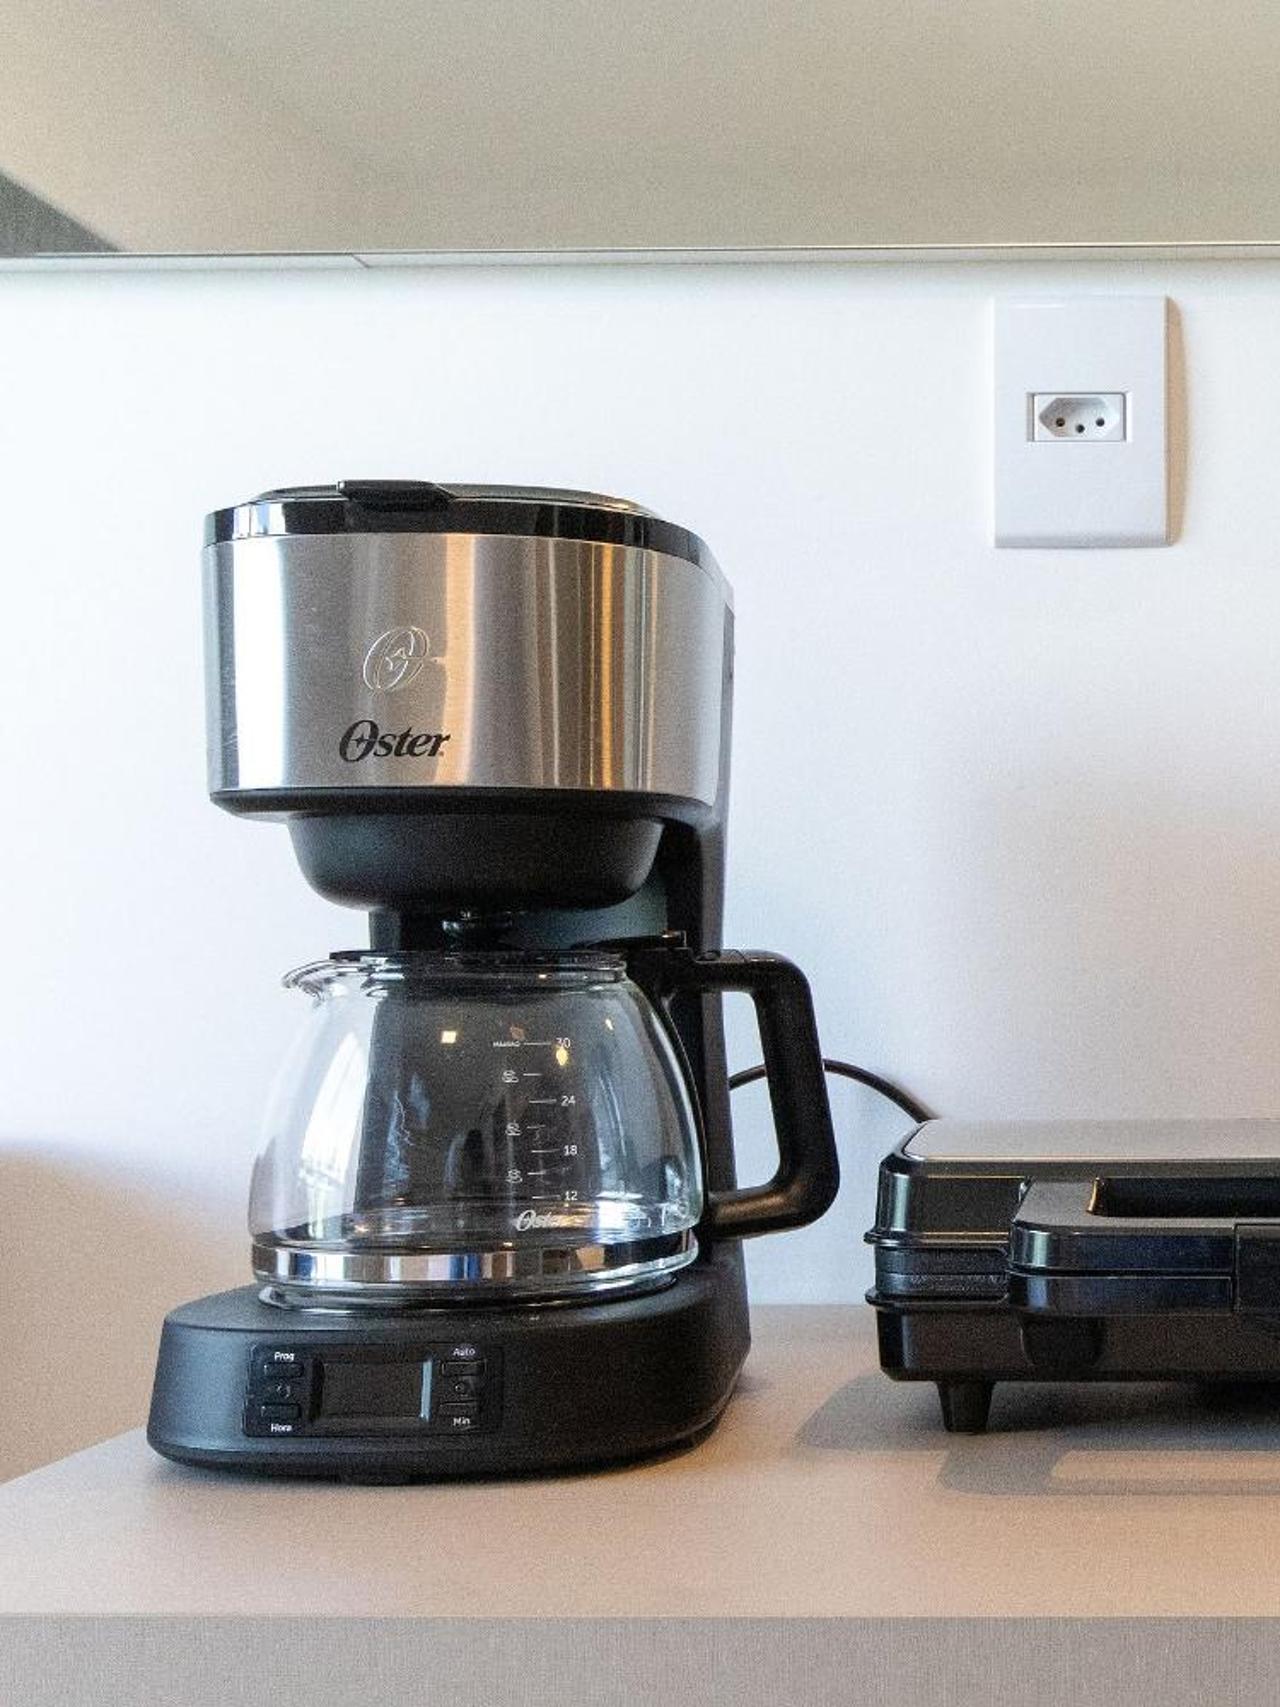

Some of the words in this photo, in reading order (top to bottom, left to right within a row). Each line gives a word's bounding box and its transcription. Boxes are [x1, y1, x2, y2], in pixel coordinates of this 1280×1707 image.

[339, 719, 451, 763] Oster
[561, 1095, 576, 1107] 24
[564, 1145, 578, 1156] 18
[564, 1190, 578, 1201] 12
[274, 1351, 295, 1363] Prog
[452, 1347, 477, 1356] Auto
[452, 1416, 471, 1427] Min
[270, 1423, 293, 1433] Hora
